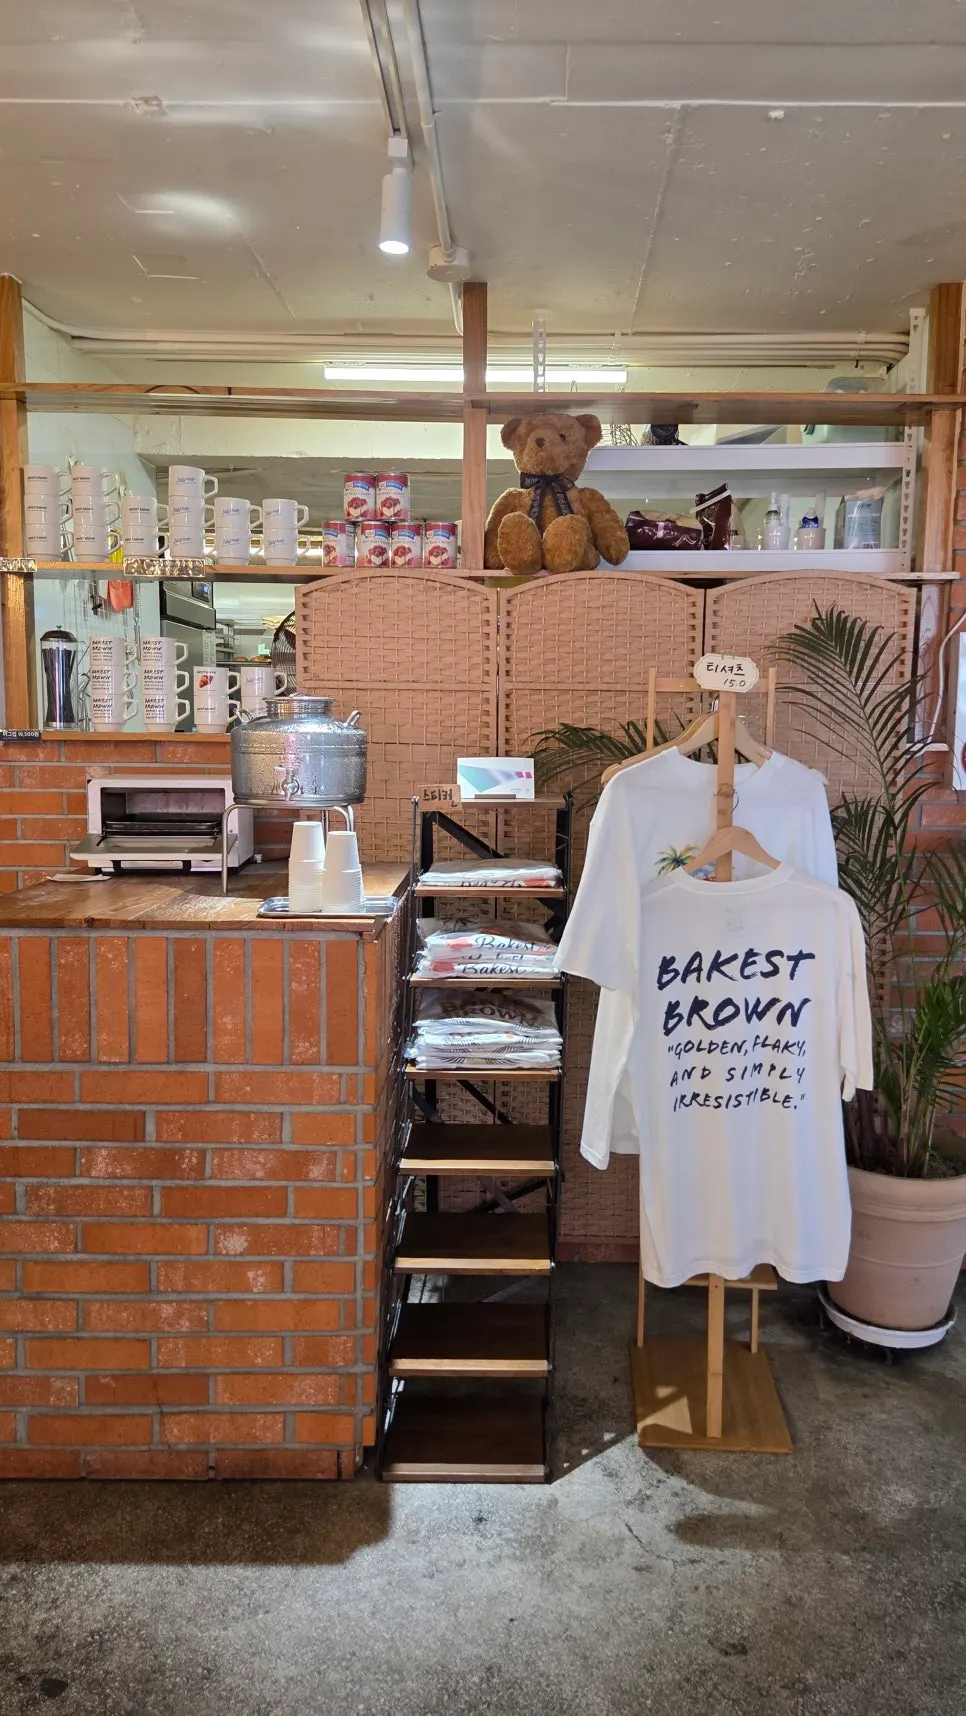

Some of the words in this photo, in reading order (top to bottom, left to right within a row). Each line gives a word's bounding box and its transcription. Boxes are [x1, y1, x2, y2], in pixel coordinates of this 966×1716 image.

[706, 662, 745, 676] 티셔츠
[723, 678, 746, 688] 15.0
[475, 936, 535, 952] Bakest
[656, 948, 816, 991] BAKEST
[662, 995, 812, 1037] BROWN
[669, 1066, 712, 1087] AND
[725, 1062, 806, 1083] SIMPLY
